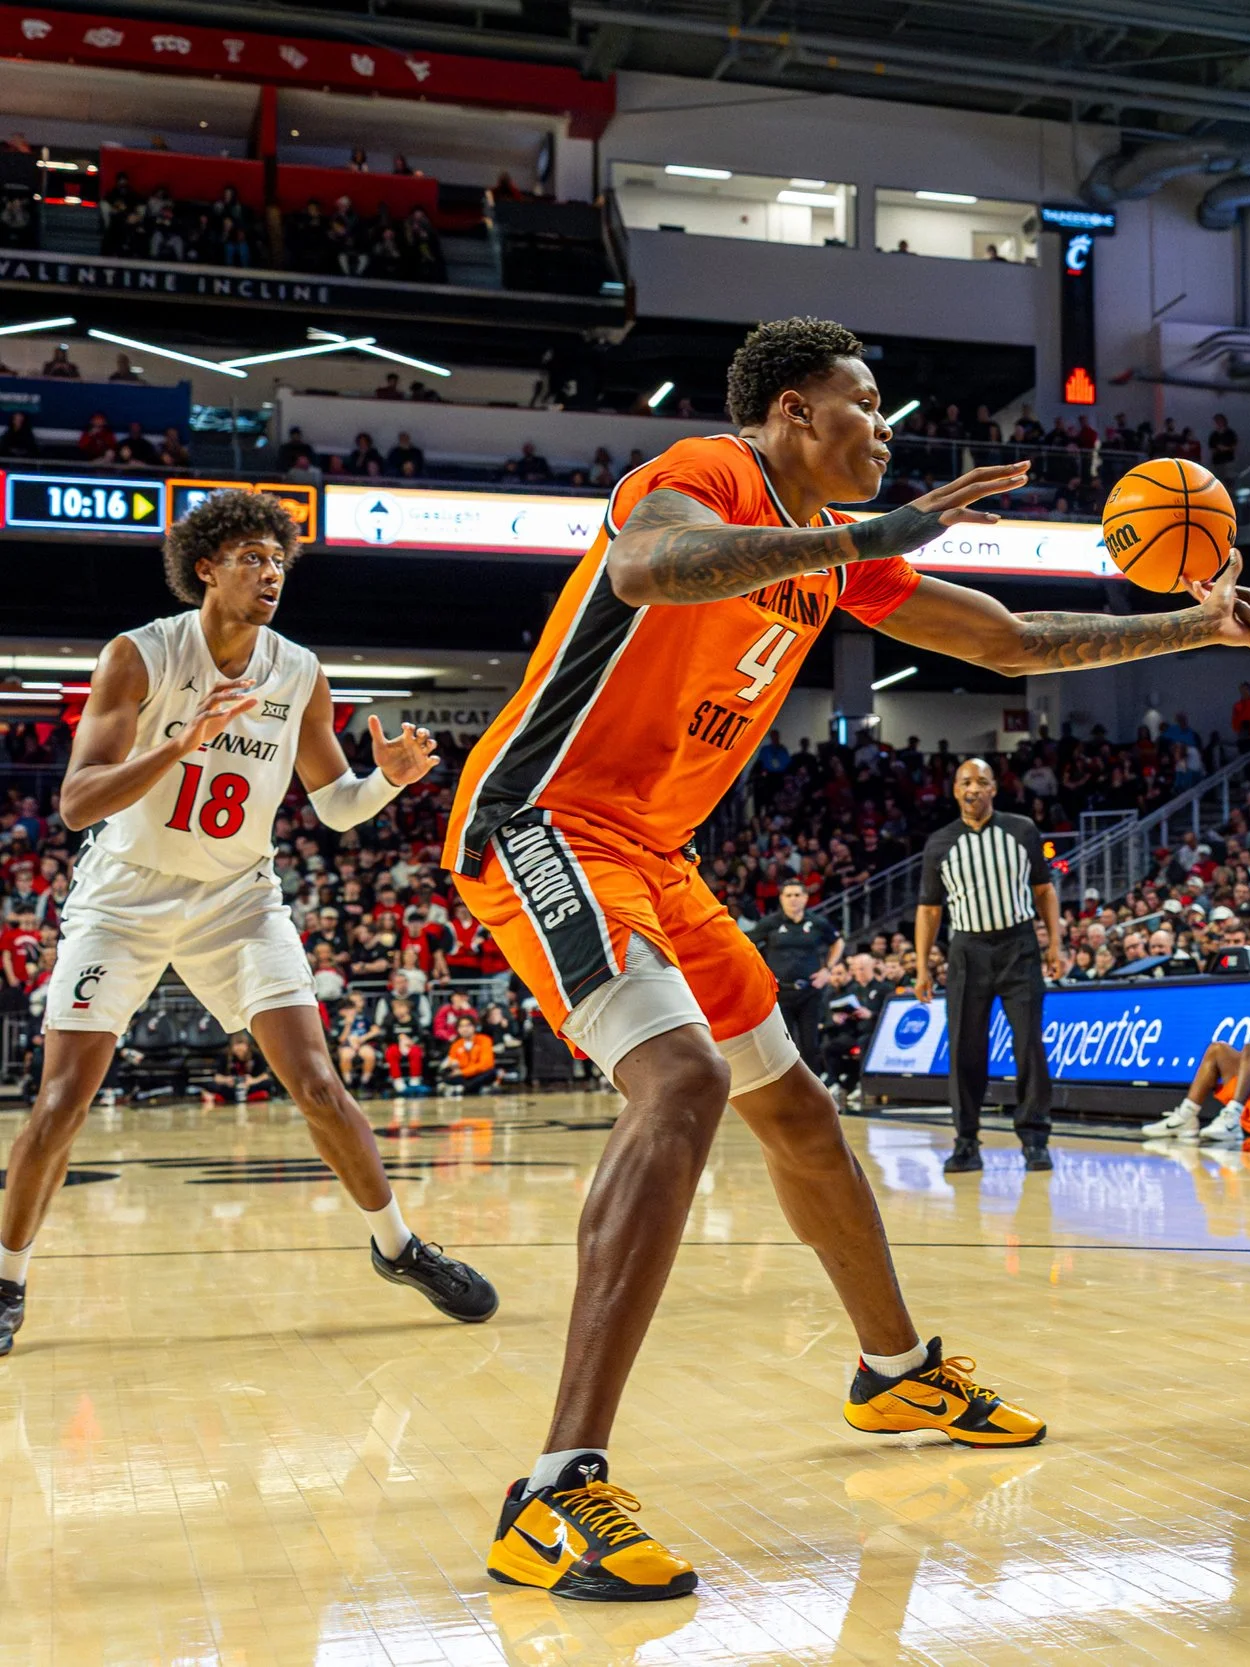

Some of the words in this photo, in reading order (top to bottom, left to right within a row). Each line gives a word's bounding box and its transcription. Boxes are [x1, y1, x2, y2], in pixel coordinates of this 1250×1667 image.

[0, 261, 177, 292] VALENTINE
[198, 276, 329, 304] INCLINE
[47, 486, 128, 520] 10:16
[734, 623, 798, 702] 4
[687, 700, 754, 751] STAT
[165, 761, 250, 839] 18
